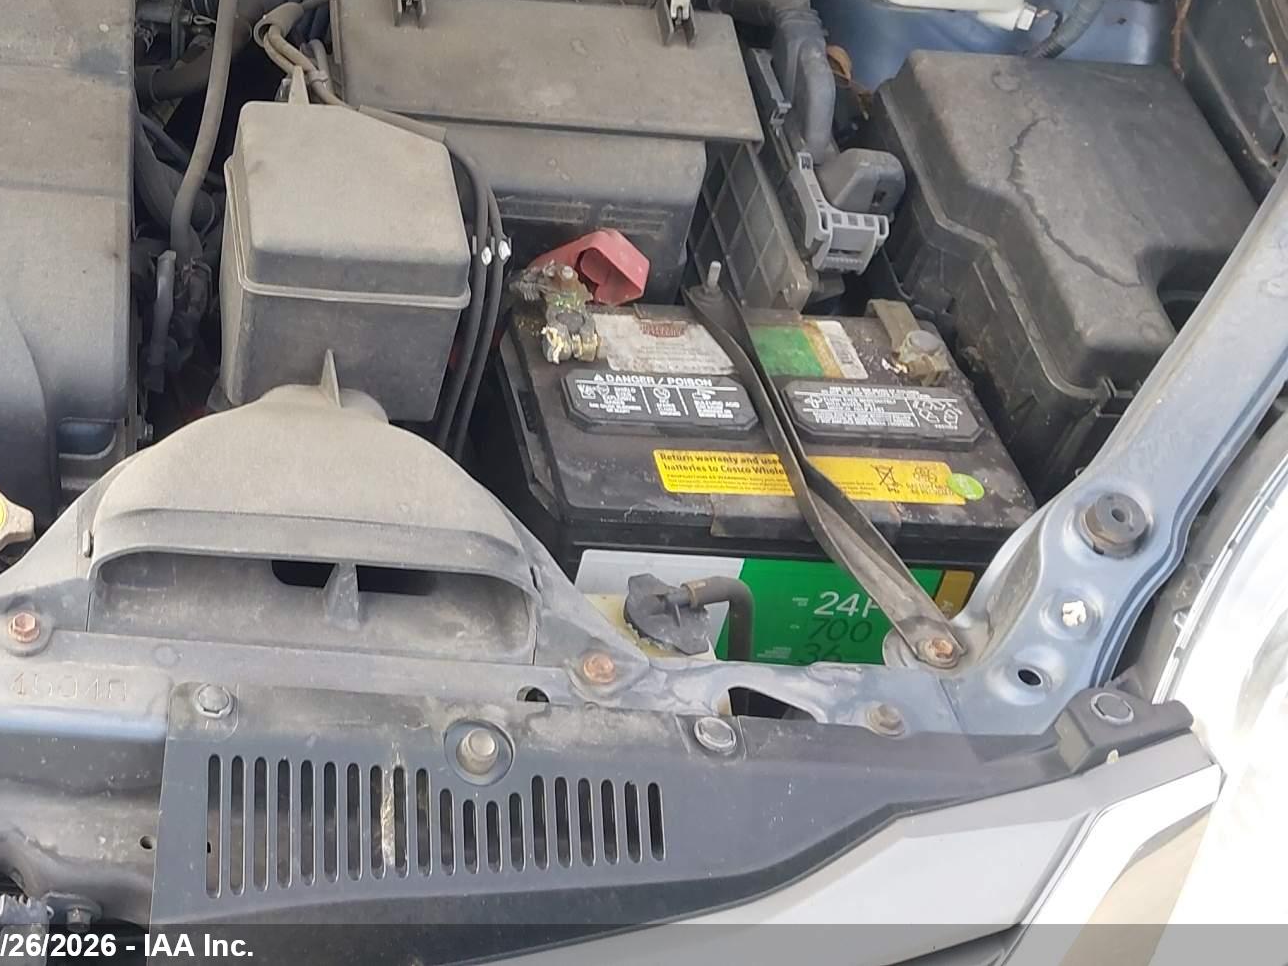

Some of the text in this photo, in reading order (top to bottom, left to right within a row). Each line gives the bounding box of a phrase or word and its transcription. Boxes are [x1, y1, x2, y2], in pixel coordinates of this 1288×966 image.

[605, 374, 655, 385] DANGER
[667, 377, 713, 387] POISON
[660, 452, 783, 465] Return warranty and use
[664, 463, 784, 475] batteries to Costco Whole
[807, 617, 873, 643] 700
